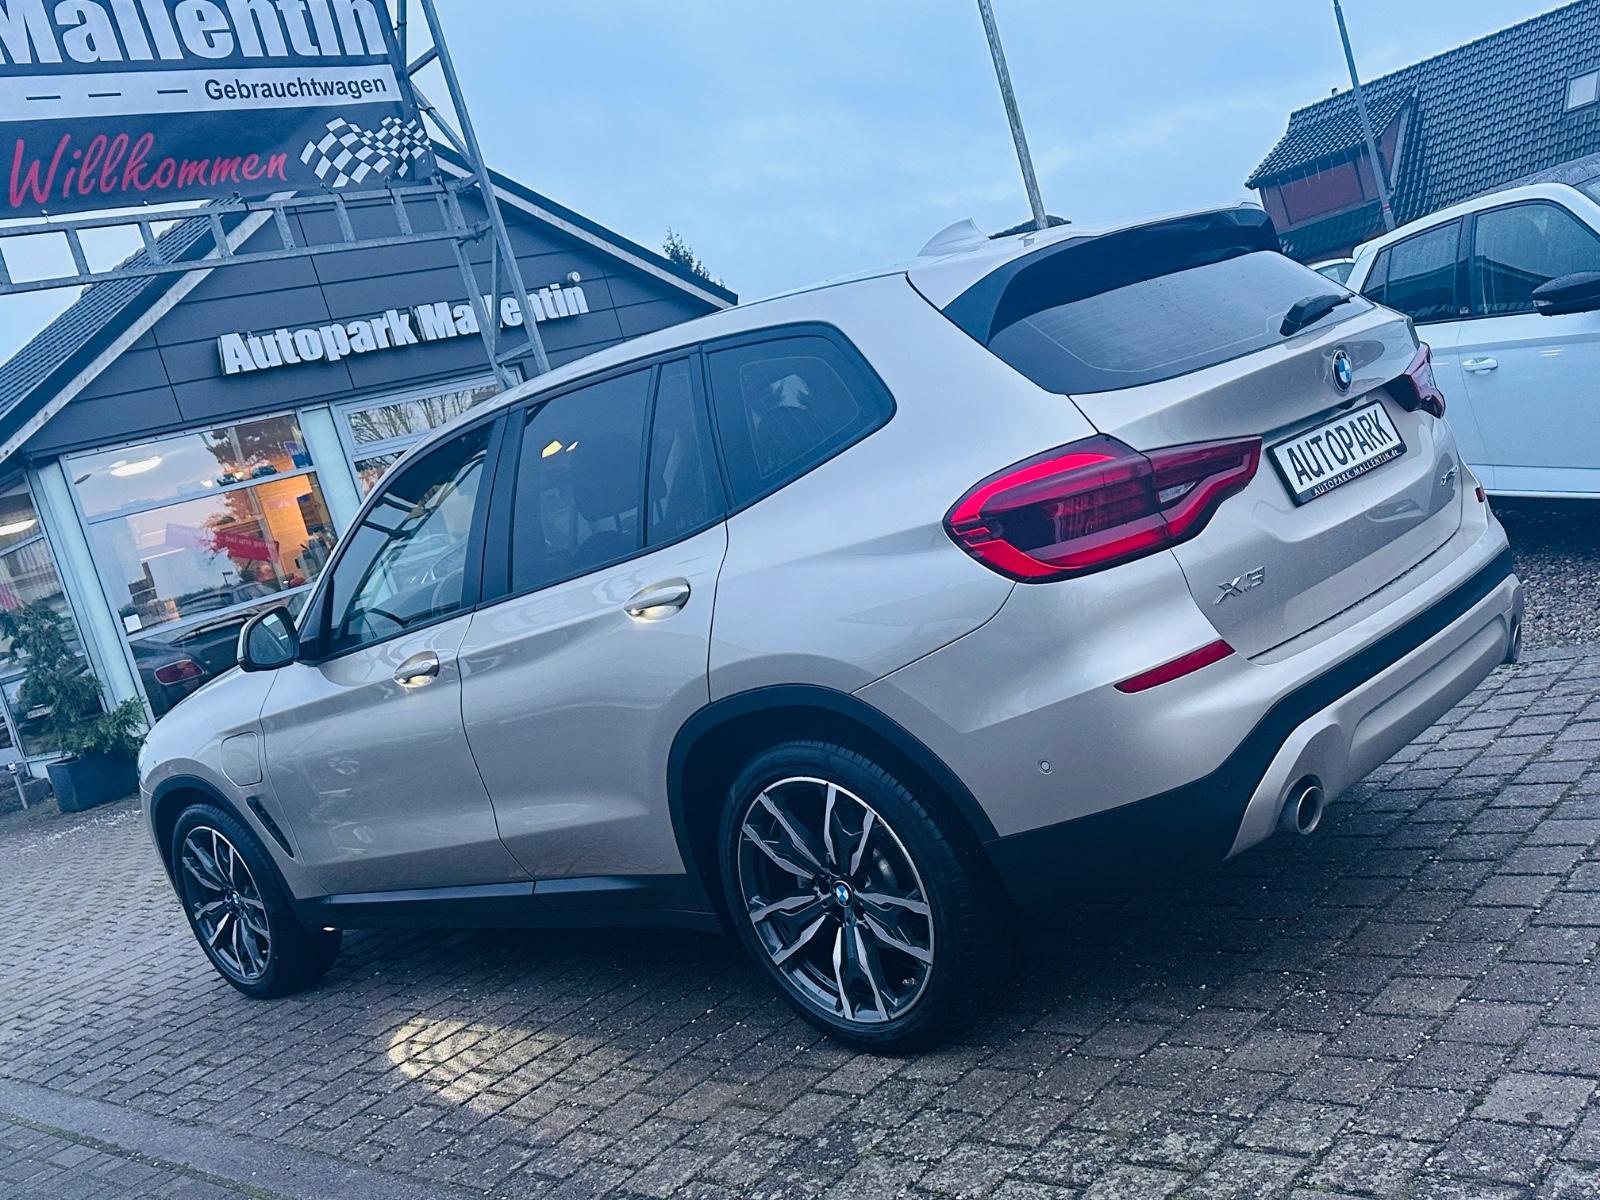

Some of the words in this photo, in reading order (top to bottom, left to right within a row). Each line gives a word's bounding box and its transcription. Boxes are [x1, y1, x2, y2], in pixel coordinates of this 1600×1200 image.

[204, 77, 387, 100] Gebrauchtwagen
[9, 132, 289, 208] Willkommen
[217, 308, 419, 376] Autopark
[1286, 409, 1394, 486] AUTOPARK
[1213, 565, 1265, 605] X3
